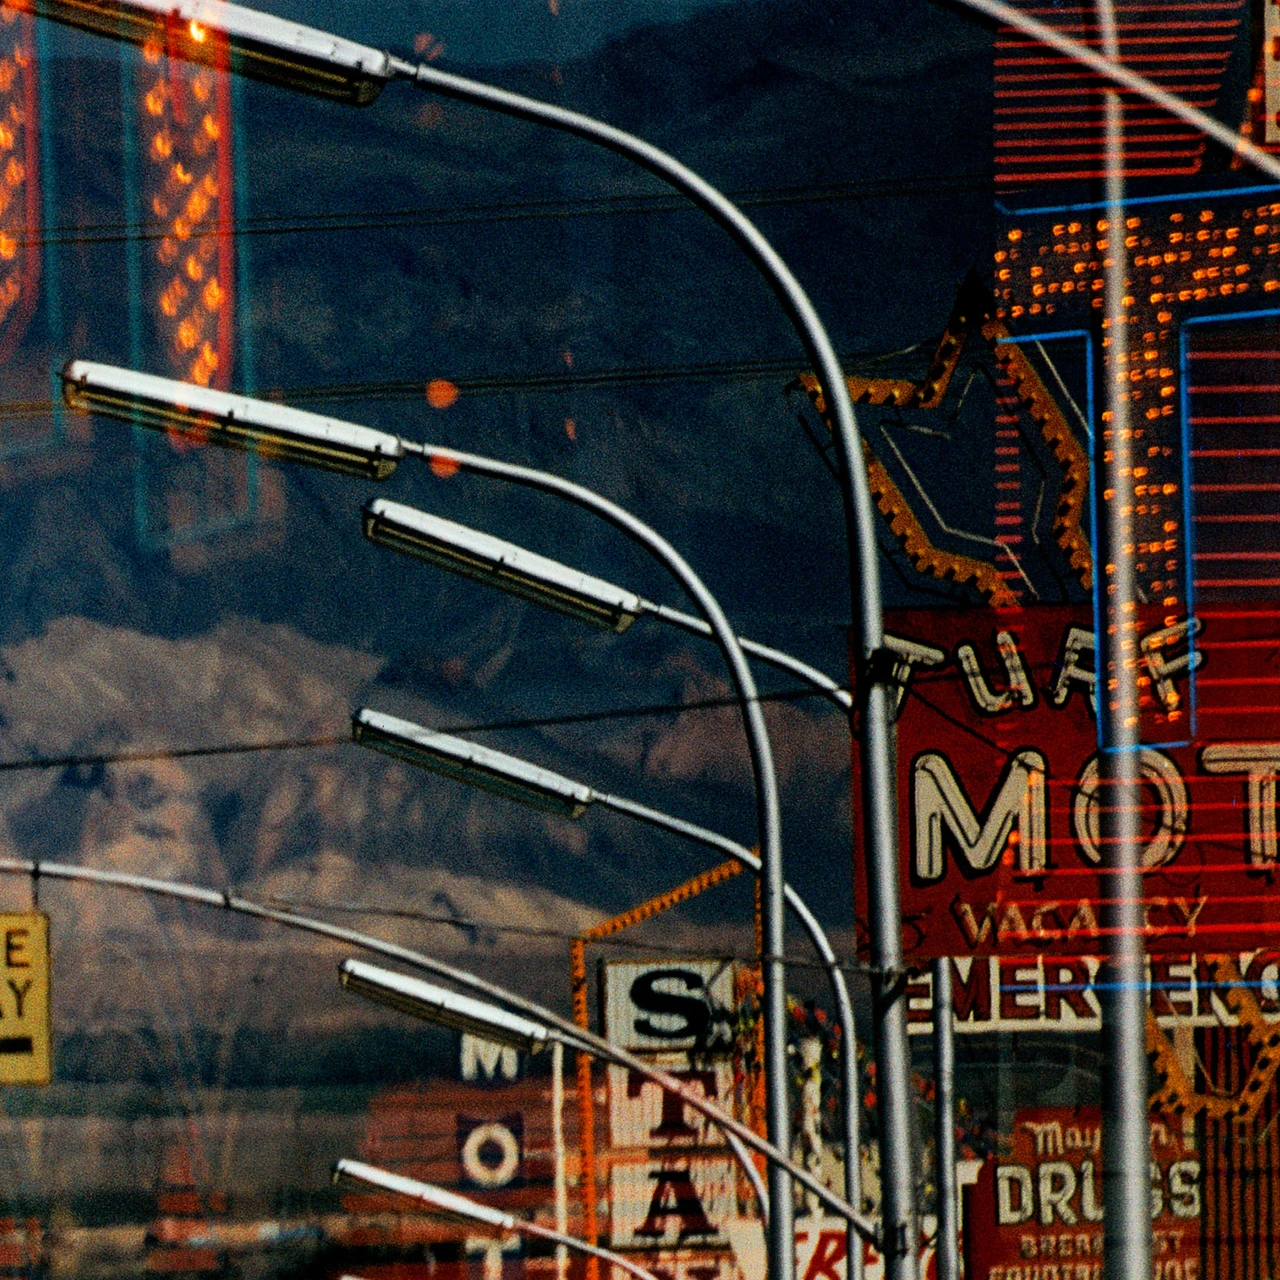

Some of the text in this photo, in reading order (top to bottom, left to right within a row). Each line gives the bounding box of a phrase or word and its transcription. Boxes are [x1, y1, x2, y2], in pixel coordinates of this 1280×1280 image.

[880, 618, 1203, 716] TURF
[957, 893, 1208, 944] VACACY
[907, 953, 1280, 1022] EMEREN
[1021, 1230, 1185, 1258] BREAST
